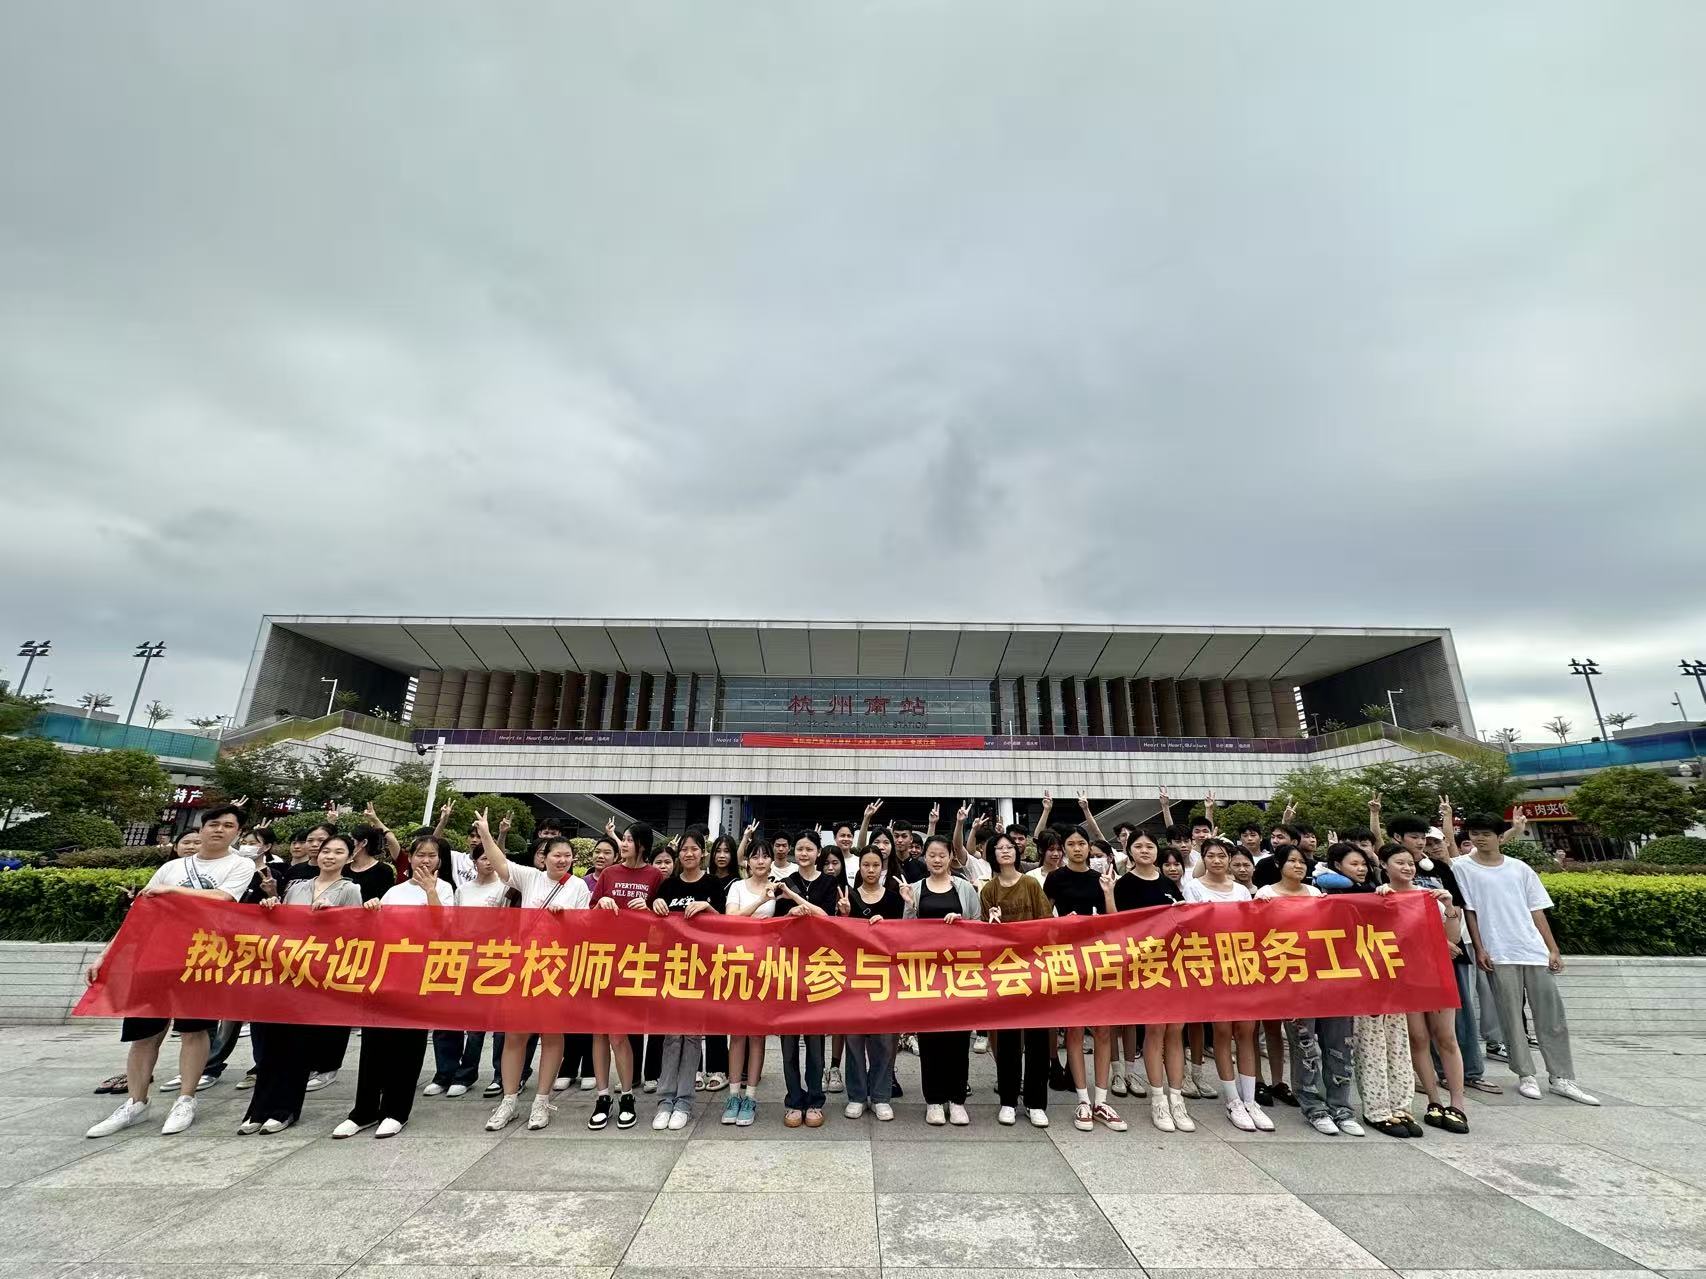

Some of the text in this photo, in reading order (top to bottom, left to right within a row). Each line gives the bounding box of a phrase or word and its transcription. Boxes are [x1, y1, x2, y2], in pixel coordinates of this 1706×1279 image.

[787, 694, 927, 716] 杭州南站
[612, 889, 626, 897] WILL
[614, 882, 649, 891] EVERYTHING
[180, 924, 1404, 1003] 热烈欢迎广西艺校师生赴杭州参与亚运会酒店接待服务工作
